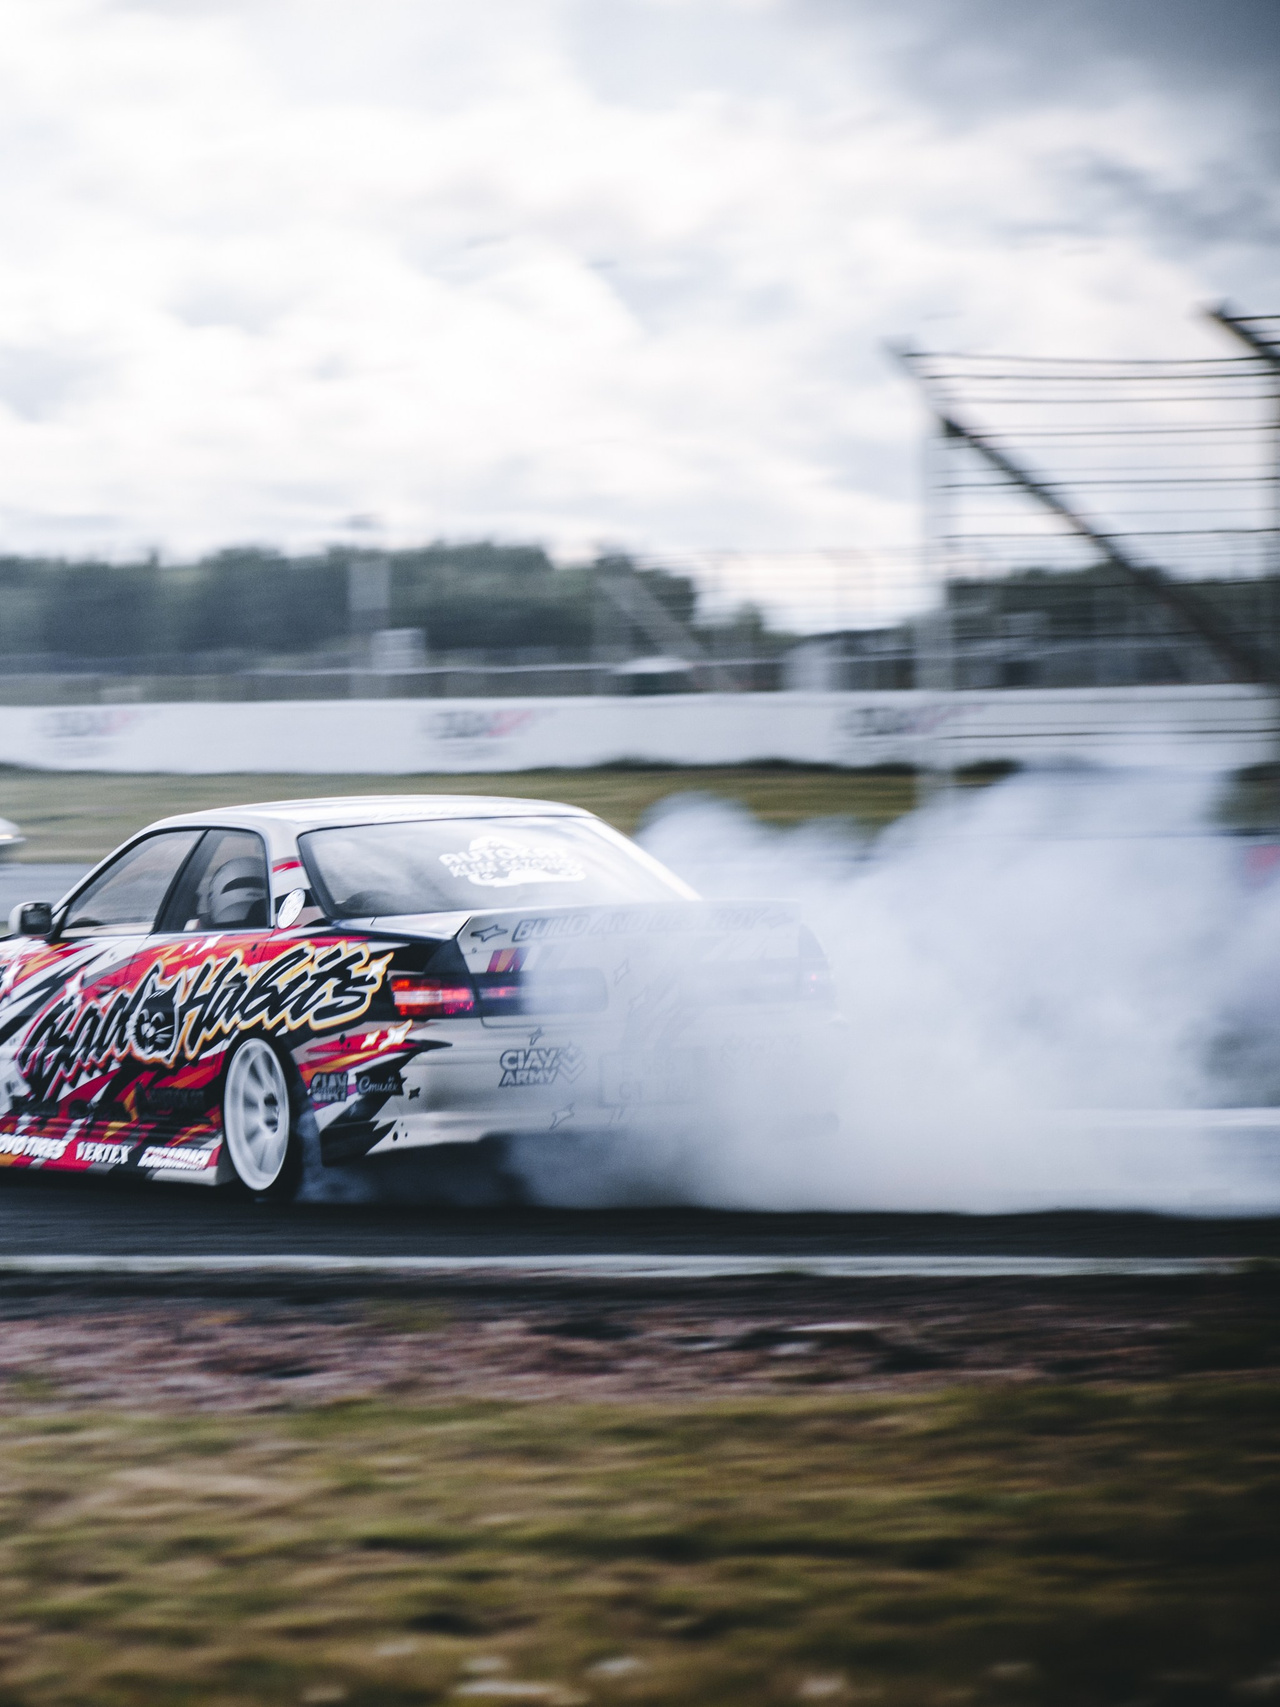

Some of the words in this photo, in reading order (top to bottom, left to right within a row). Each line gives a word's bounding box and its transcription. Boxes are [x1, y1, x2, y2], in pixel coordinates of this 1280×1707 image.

[512, 914, 590, 942] BUILD
[181, 940, 383, 1061] Habits
[499, 1070, 557, 1086] ARMY
[75, 1140, 133, 1165] VERTEX
